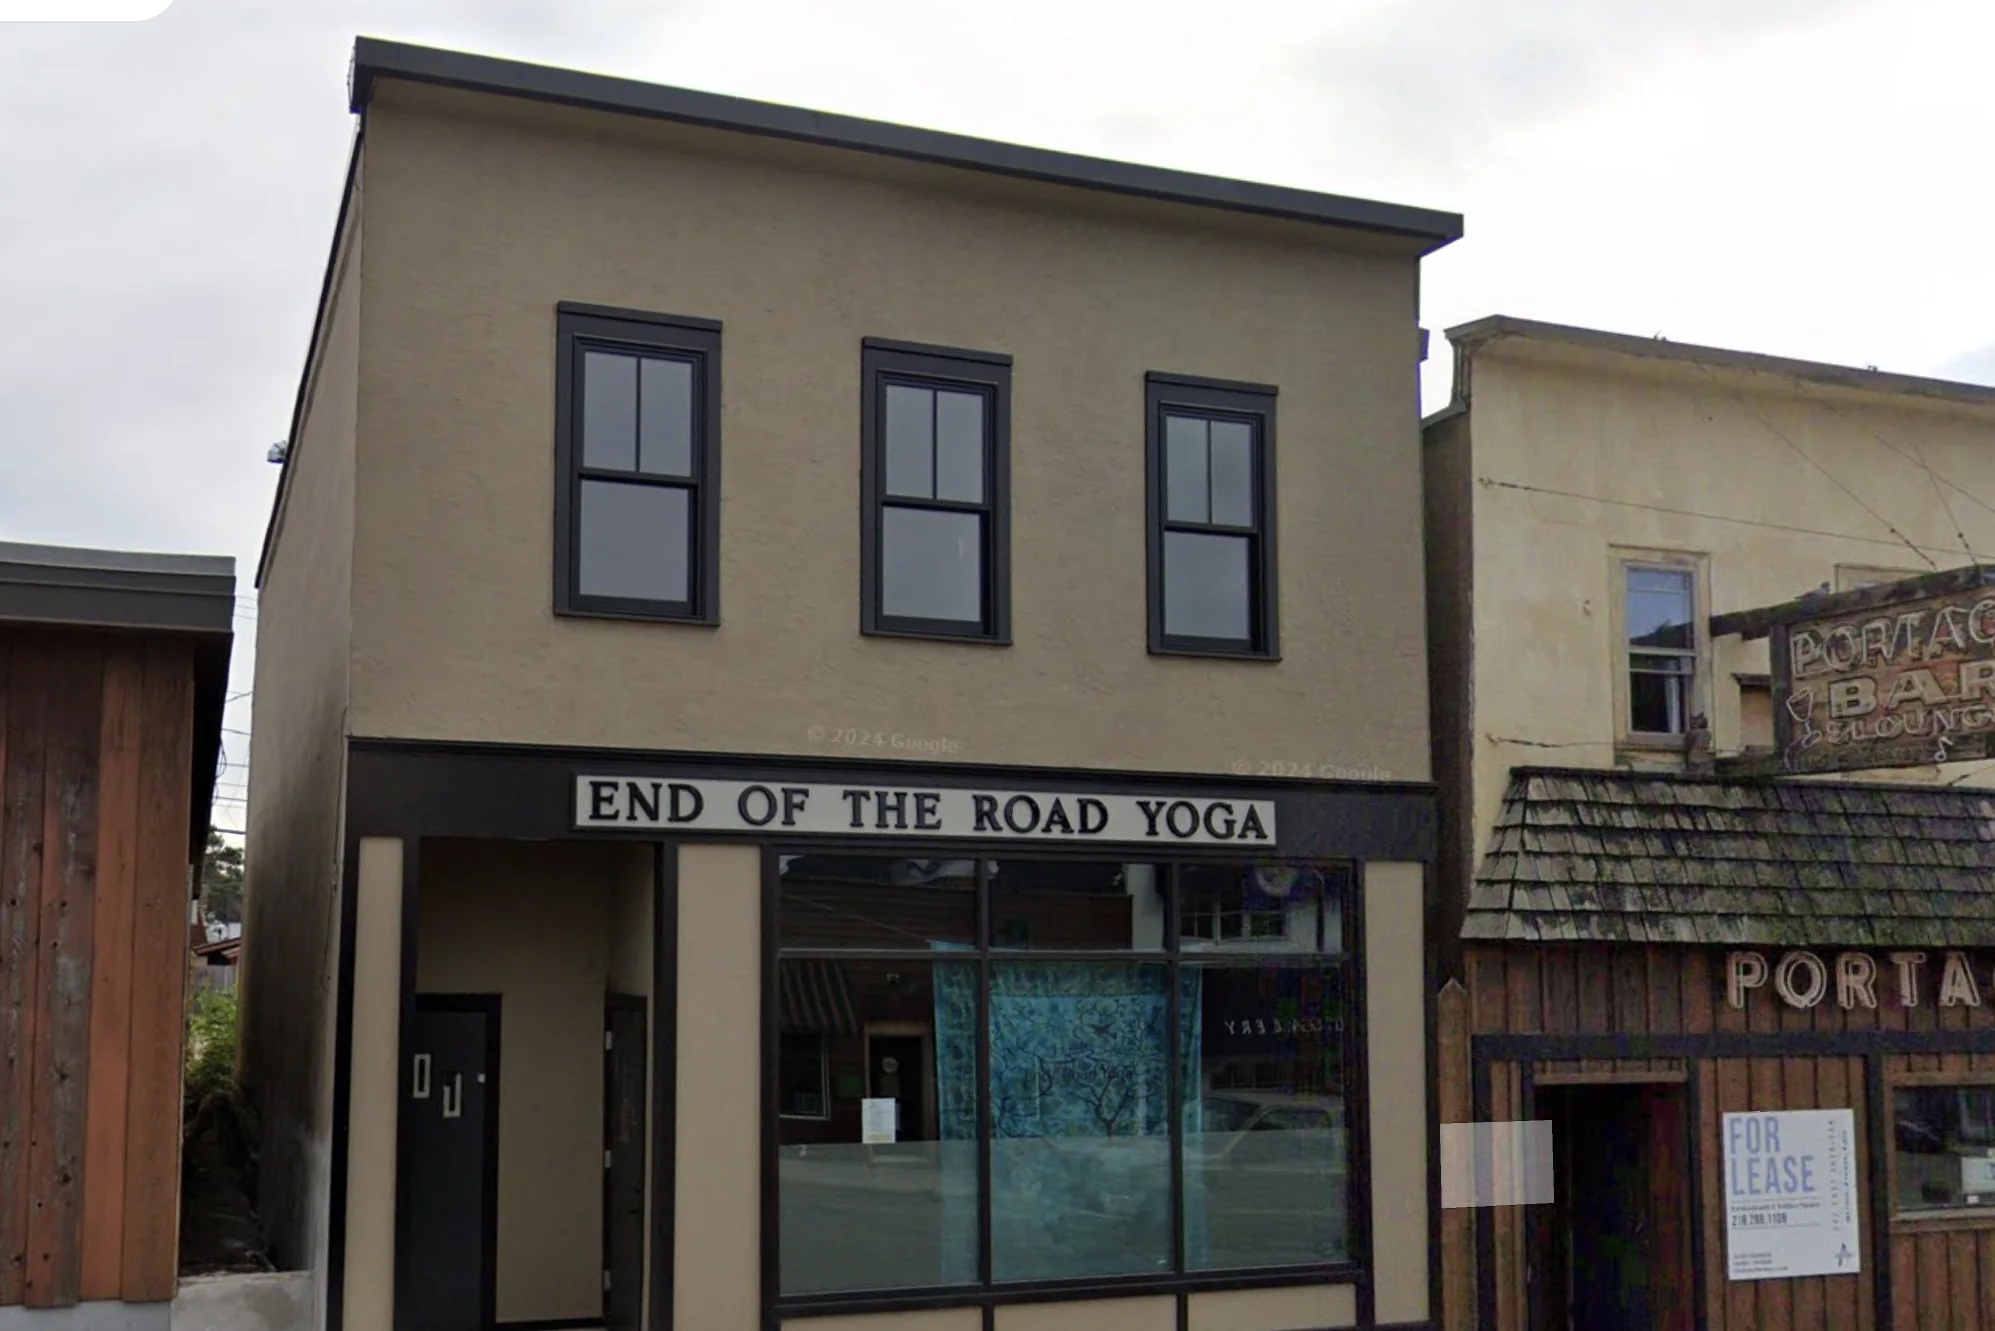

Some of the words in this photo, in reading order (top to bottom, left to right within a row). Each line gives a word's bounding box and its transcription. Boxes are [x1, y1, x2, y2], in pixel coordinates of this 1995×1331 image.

[1829, 658, 1995, 718] BAR
[589, 780, 704, 823] END
[738, 785, 809, 826] OF
[843, 789, 942, 829] THE
[972, 794, 1109, 834] ROAD
[1136, 800, 1268, 839] YOGA
[1727, 950, 1995, 1009] PORTA
[1729, 1115, 1781, 1154] FOR
[1731, 1154, 1815, 1196] LEASE
